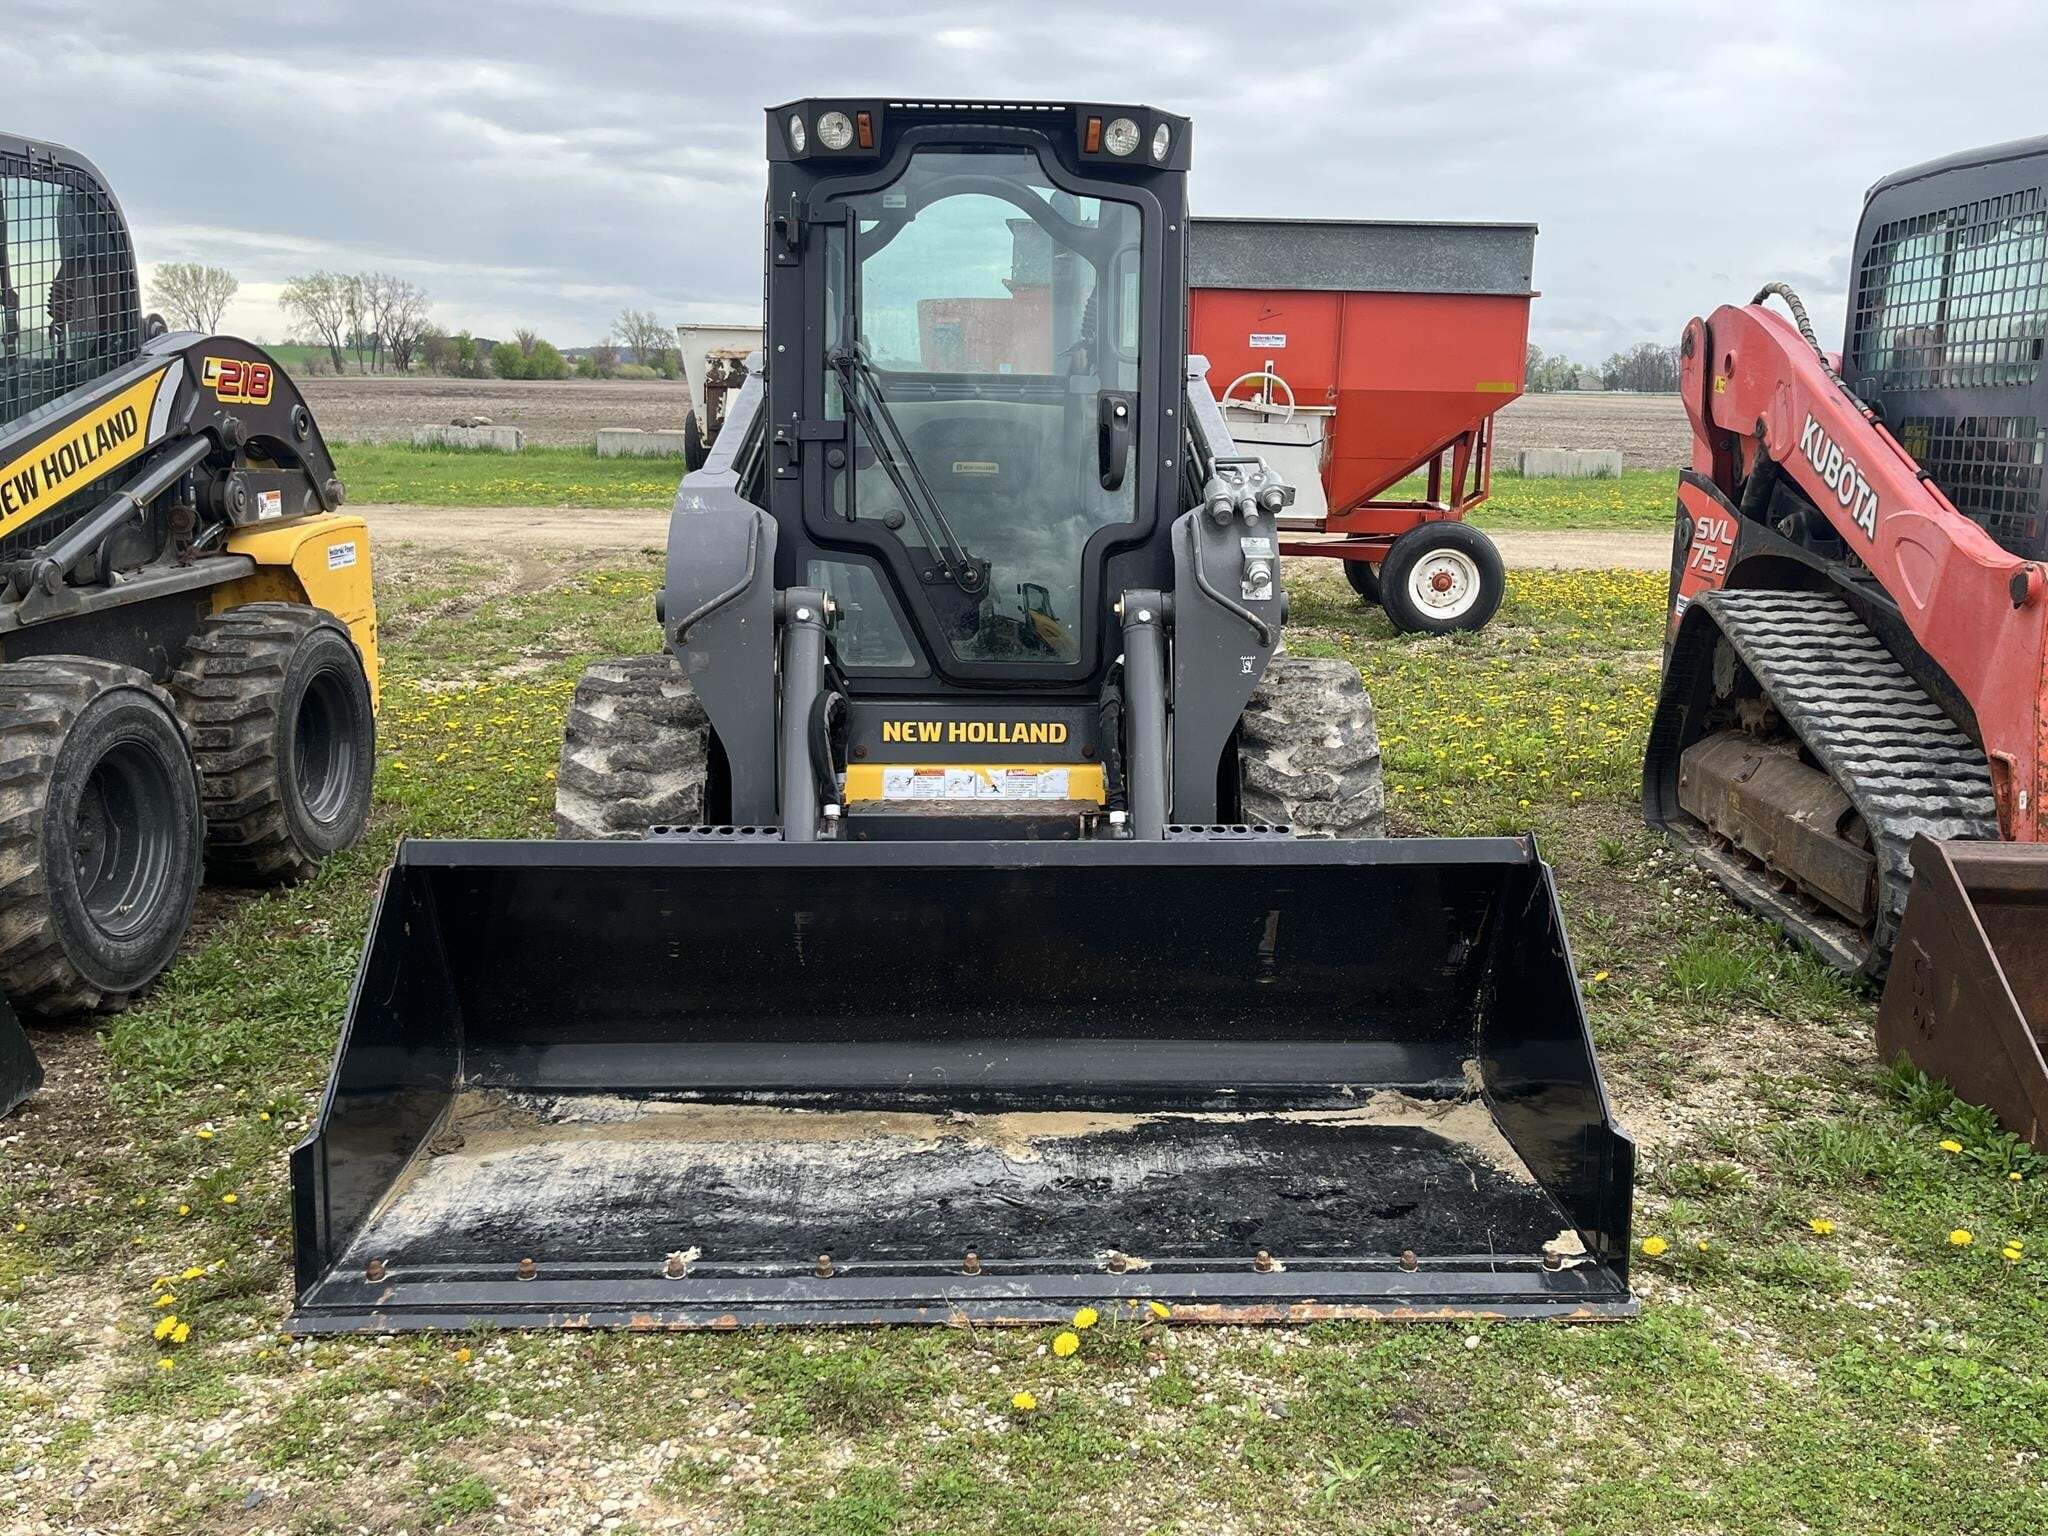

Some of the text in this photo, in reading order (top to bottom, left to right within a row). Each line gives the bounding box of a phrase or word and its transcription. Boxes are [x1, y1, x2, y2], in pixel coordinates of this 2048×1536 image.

[203, 357, 273, 404] L218
[0, 405, 138, 520] EW HOLLAND
[1799, 412, 1879, 542] KUBOTA
[1695, 516, 1732, 545] SVL
[1691, 542, 1726, 576] 75-2
[882, 721, 1068, 744] NEW HOLLAND
